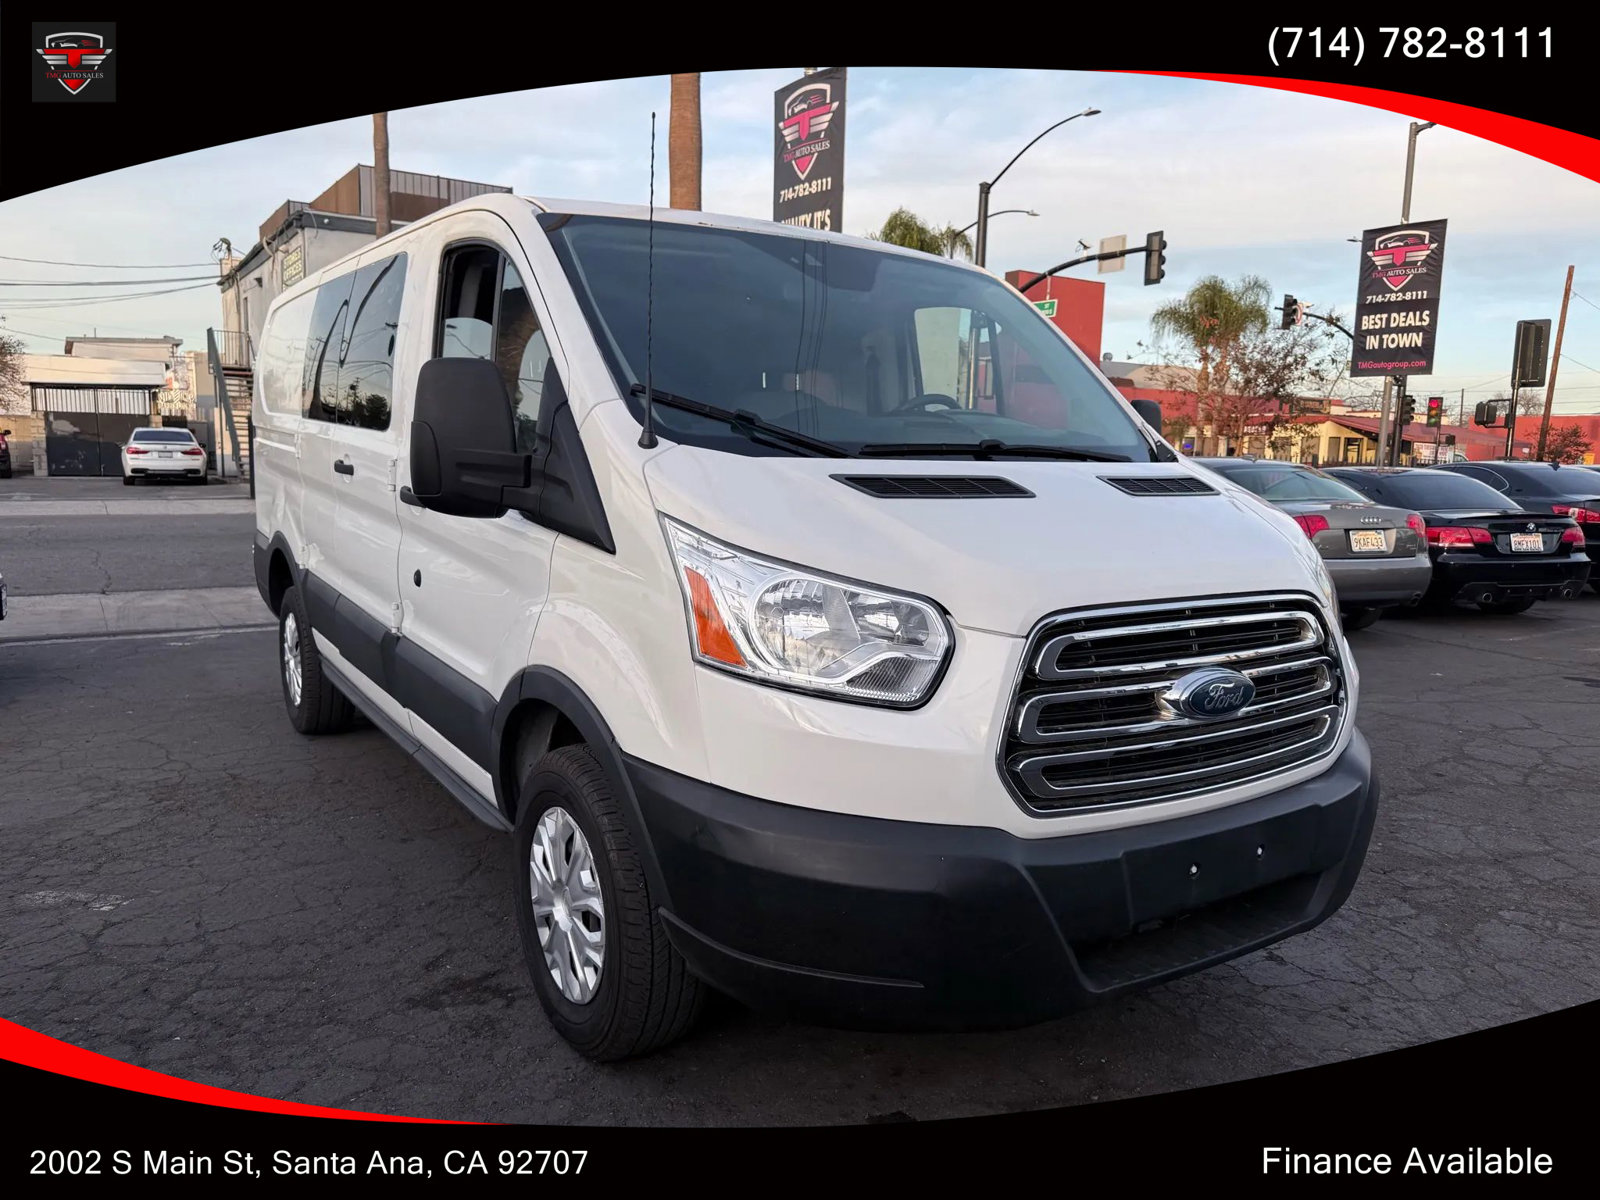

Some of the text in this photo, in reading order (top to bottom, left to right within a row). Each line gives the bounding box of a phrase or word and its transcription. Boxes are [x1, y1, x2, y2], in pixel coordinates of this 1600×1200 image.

[794, 145, 811, 159] AUTO
[811, 140, 831, 154] SALES
[779, 176, 832, 204] 714-782-8111
[1386, 268, 1405, 277] AUTO
[1405, 266, 1427, 275] SALES
[1365, 290, 1428, 305] 714-782-8111
[1361, 310, 1430, 330] BEST DEALS
[1365, 332, 1423, 350] IN TOWN
[1358, 360, 1426, 370] TMGautogroup.com
[1205, 683, 1245, 711] Ford
